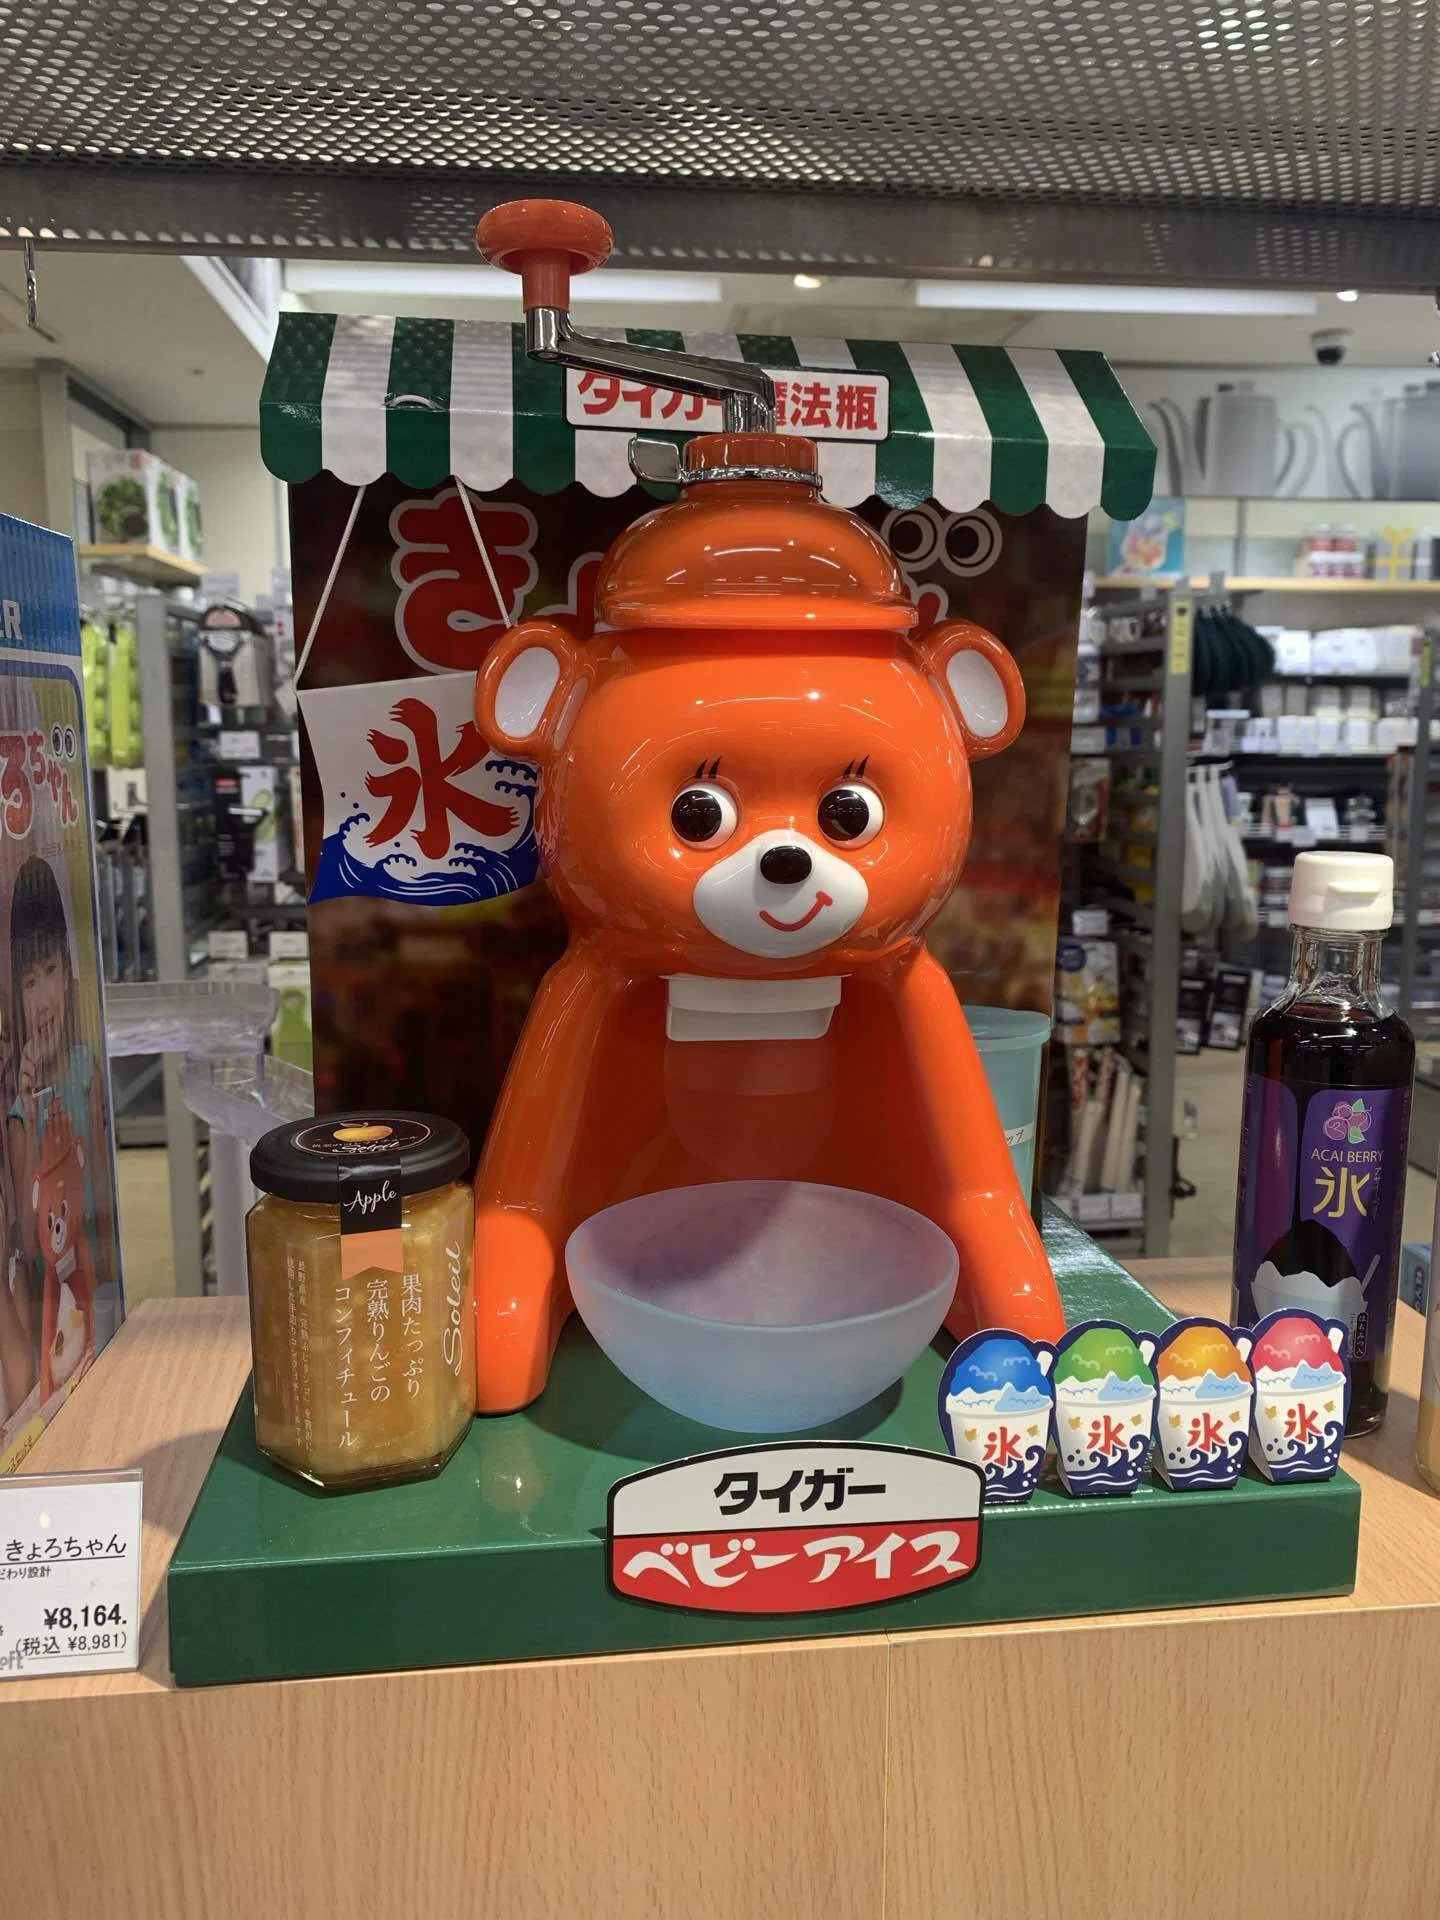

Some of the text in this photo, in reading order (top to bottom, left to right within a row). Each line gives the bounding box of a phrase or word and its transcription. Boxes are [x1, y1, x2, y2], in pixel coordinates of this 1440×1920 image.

[364, 698, 520, 860] 氷
[1311, 1149, 1384, 1163] ACAI BERRY
[343, 1180, 397, 1214] Apple
[1313, 1167, 1370, 1218] 氷
[443, 1240, 464, 1377] Soleil
[366, 1279, 391, 1402] 完熟りんごの
[401, 1274, 424, 1399] 果肉たっぷり
[335, 1287, 358, 1449] コンフィチュール
[1086, 1415, 1127, 1457] 氷
[1187, 1412, 1227, 1454] 氷
[1284, 1403, 1323, 1443] 氷
[983, 1426, 1021, 1466] 氷
[713, 1467, 887, 1516] タイガー
[6, 1534, 127, 1562] きょろちゃん
[622, 1531, 970, 1588] ベビーアイス
[44, 1603, 127, 1631] ¥8,164.
